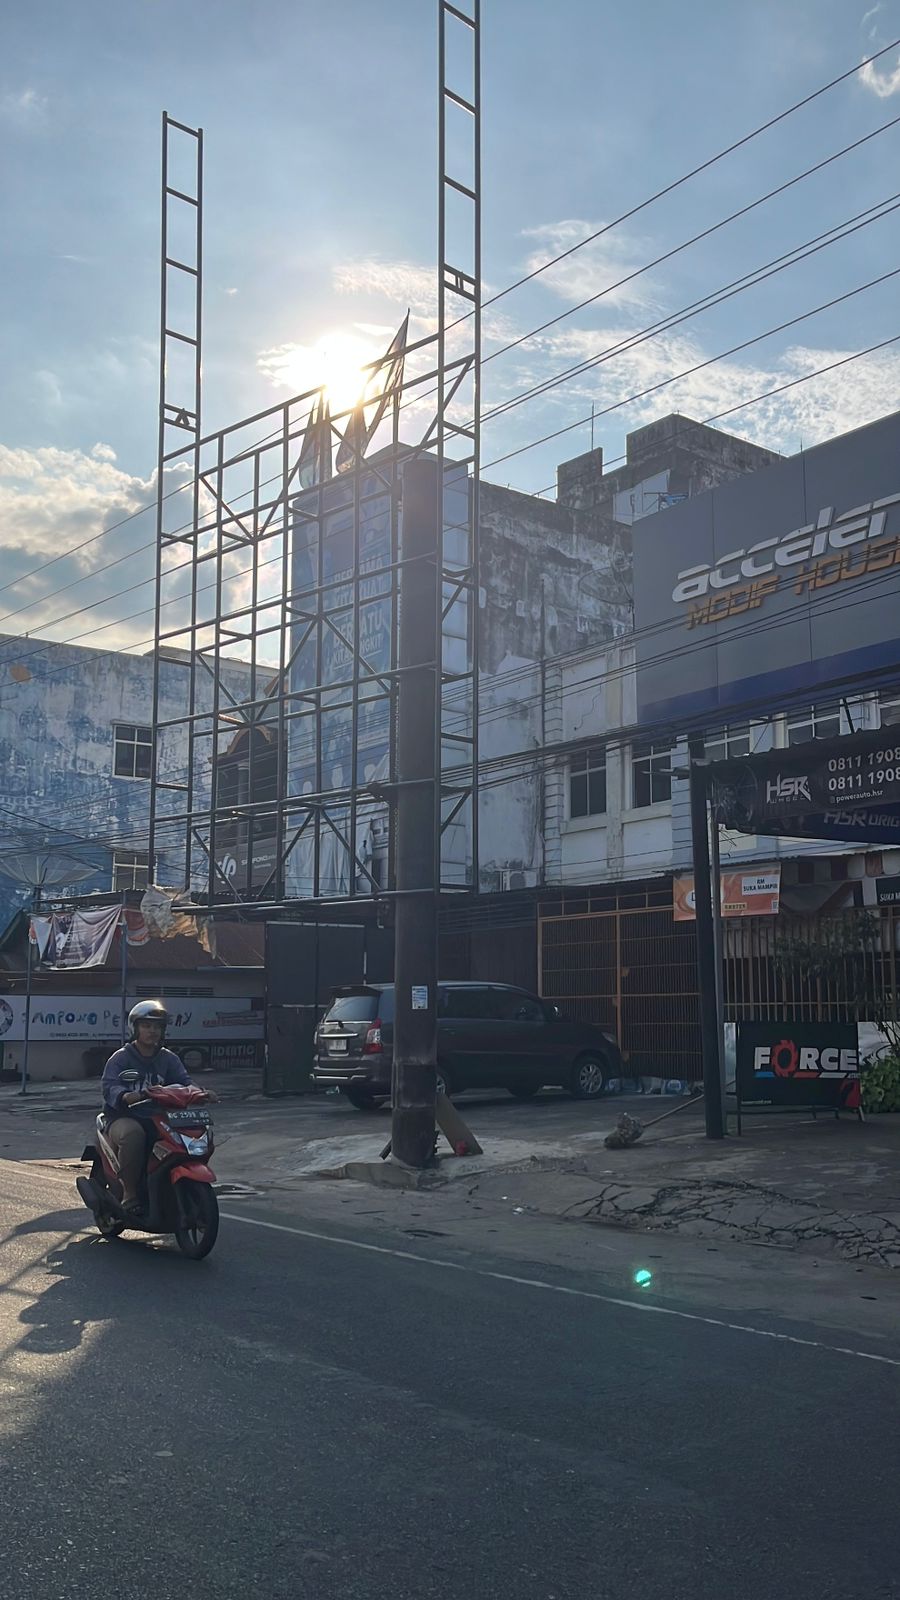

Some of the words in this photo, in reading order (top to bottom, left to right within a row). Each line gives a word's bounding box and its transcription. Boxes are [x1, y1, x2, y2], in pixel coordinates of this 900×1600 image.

[687, 575, 780, 630] MODIF
[793, 535, 900, 595] HOUS
[334, 608, 382, 648] BERATU
[828, 755, 861, 772] 0811
[766, 773, 812, 804] HSR
[828, 774, 862, 791] 0811
[836, 789, 884, 804] powerauto.hsr
[824, 809, 866, 827] HSR
[754, 1040, 858, 1077] FORCE
